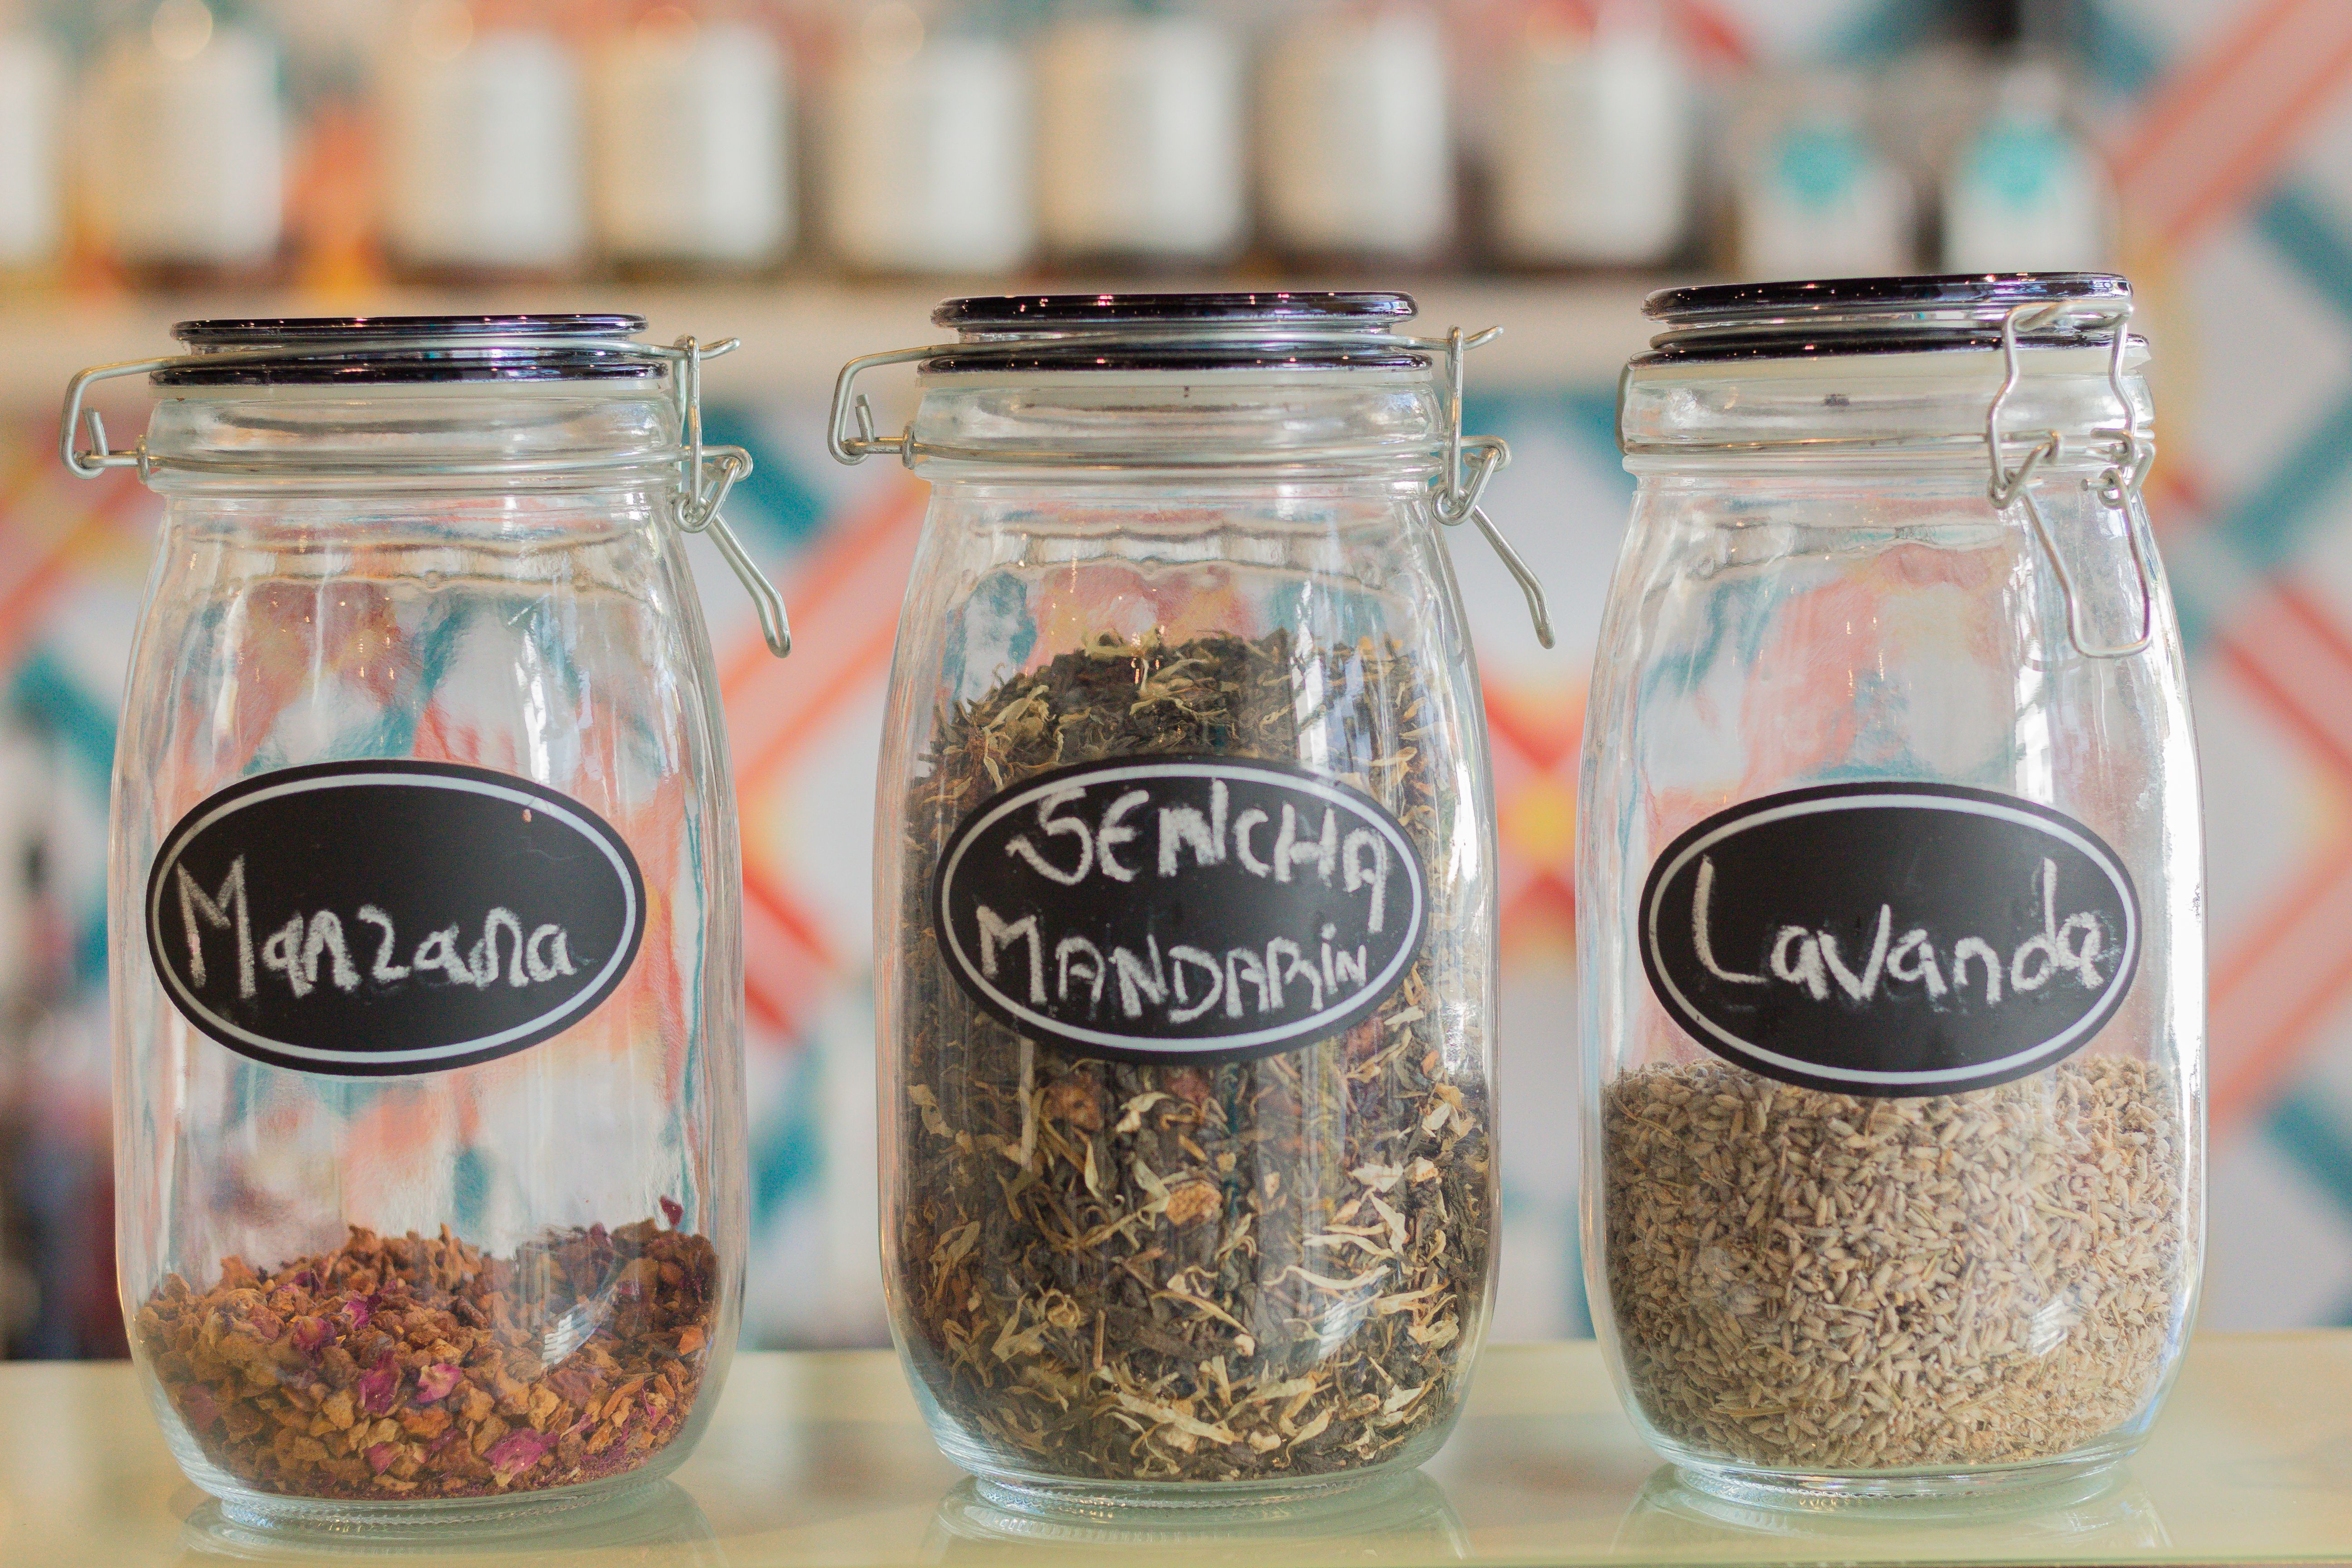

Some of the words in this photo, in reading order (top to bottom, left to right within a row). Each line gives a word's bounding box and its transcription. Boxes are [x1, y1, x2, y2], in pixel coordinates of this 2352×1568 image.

[175, 852, 578, 999] Manzana
[1005, 778, 1391, 934] SENCHA
[1691, 855, 2104, 1004] Lavanda
